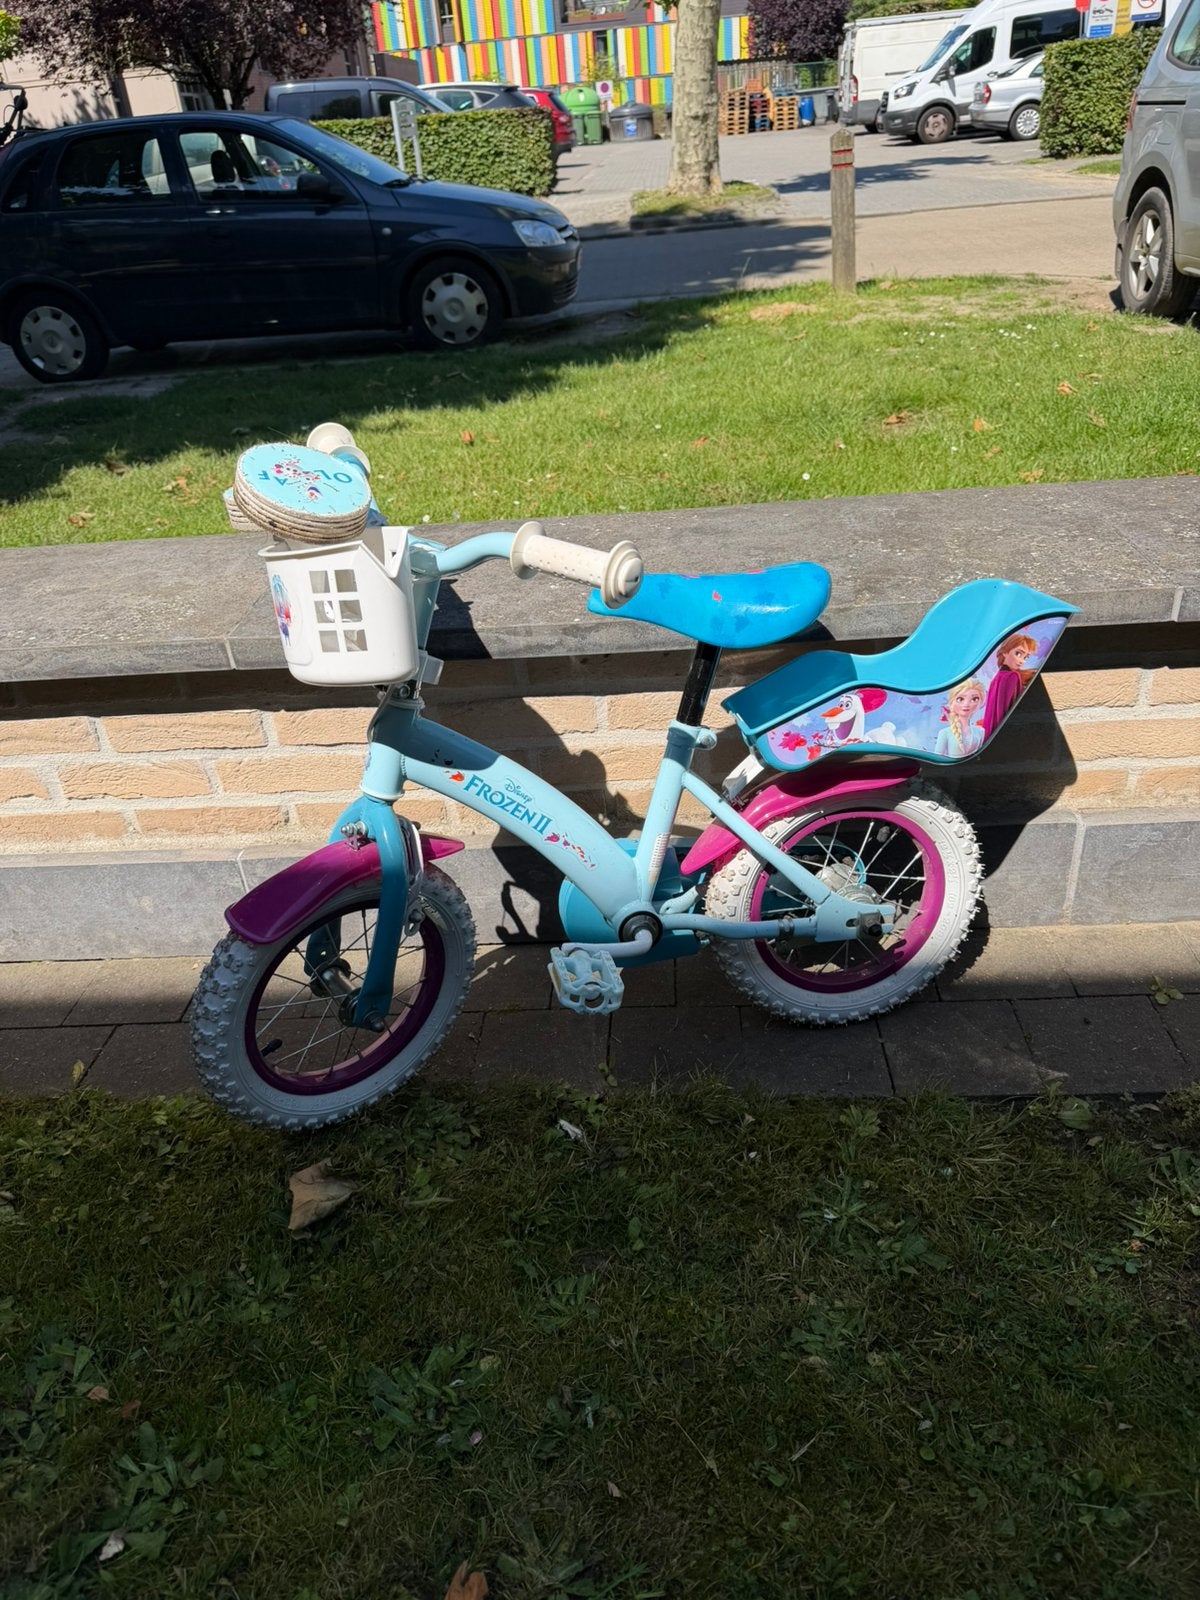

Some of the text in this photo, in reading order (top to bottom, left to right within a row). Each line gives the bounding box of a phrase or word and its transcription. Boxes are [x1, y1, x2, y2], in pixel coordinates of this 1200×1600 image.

[463, 774, 553, 835] FROZEN II
[504, 777, 533, 804] Disney
